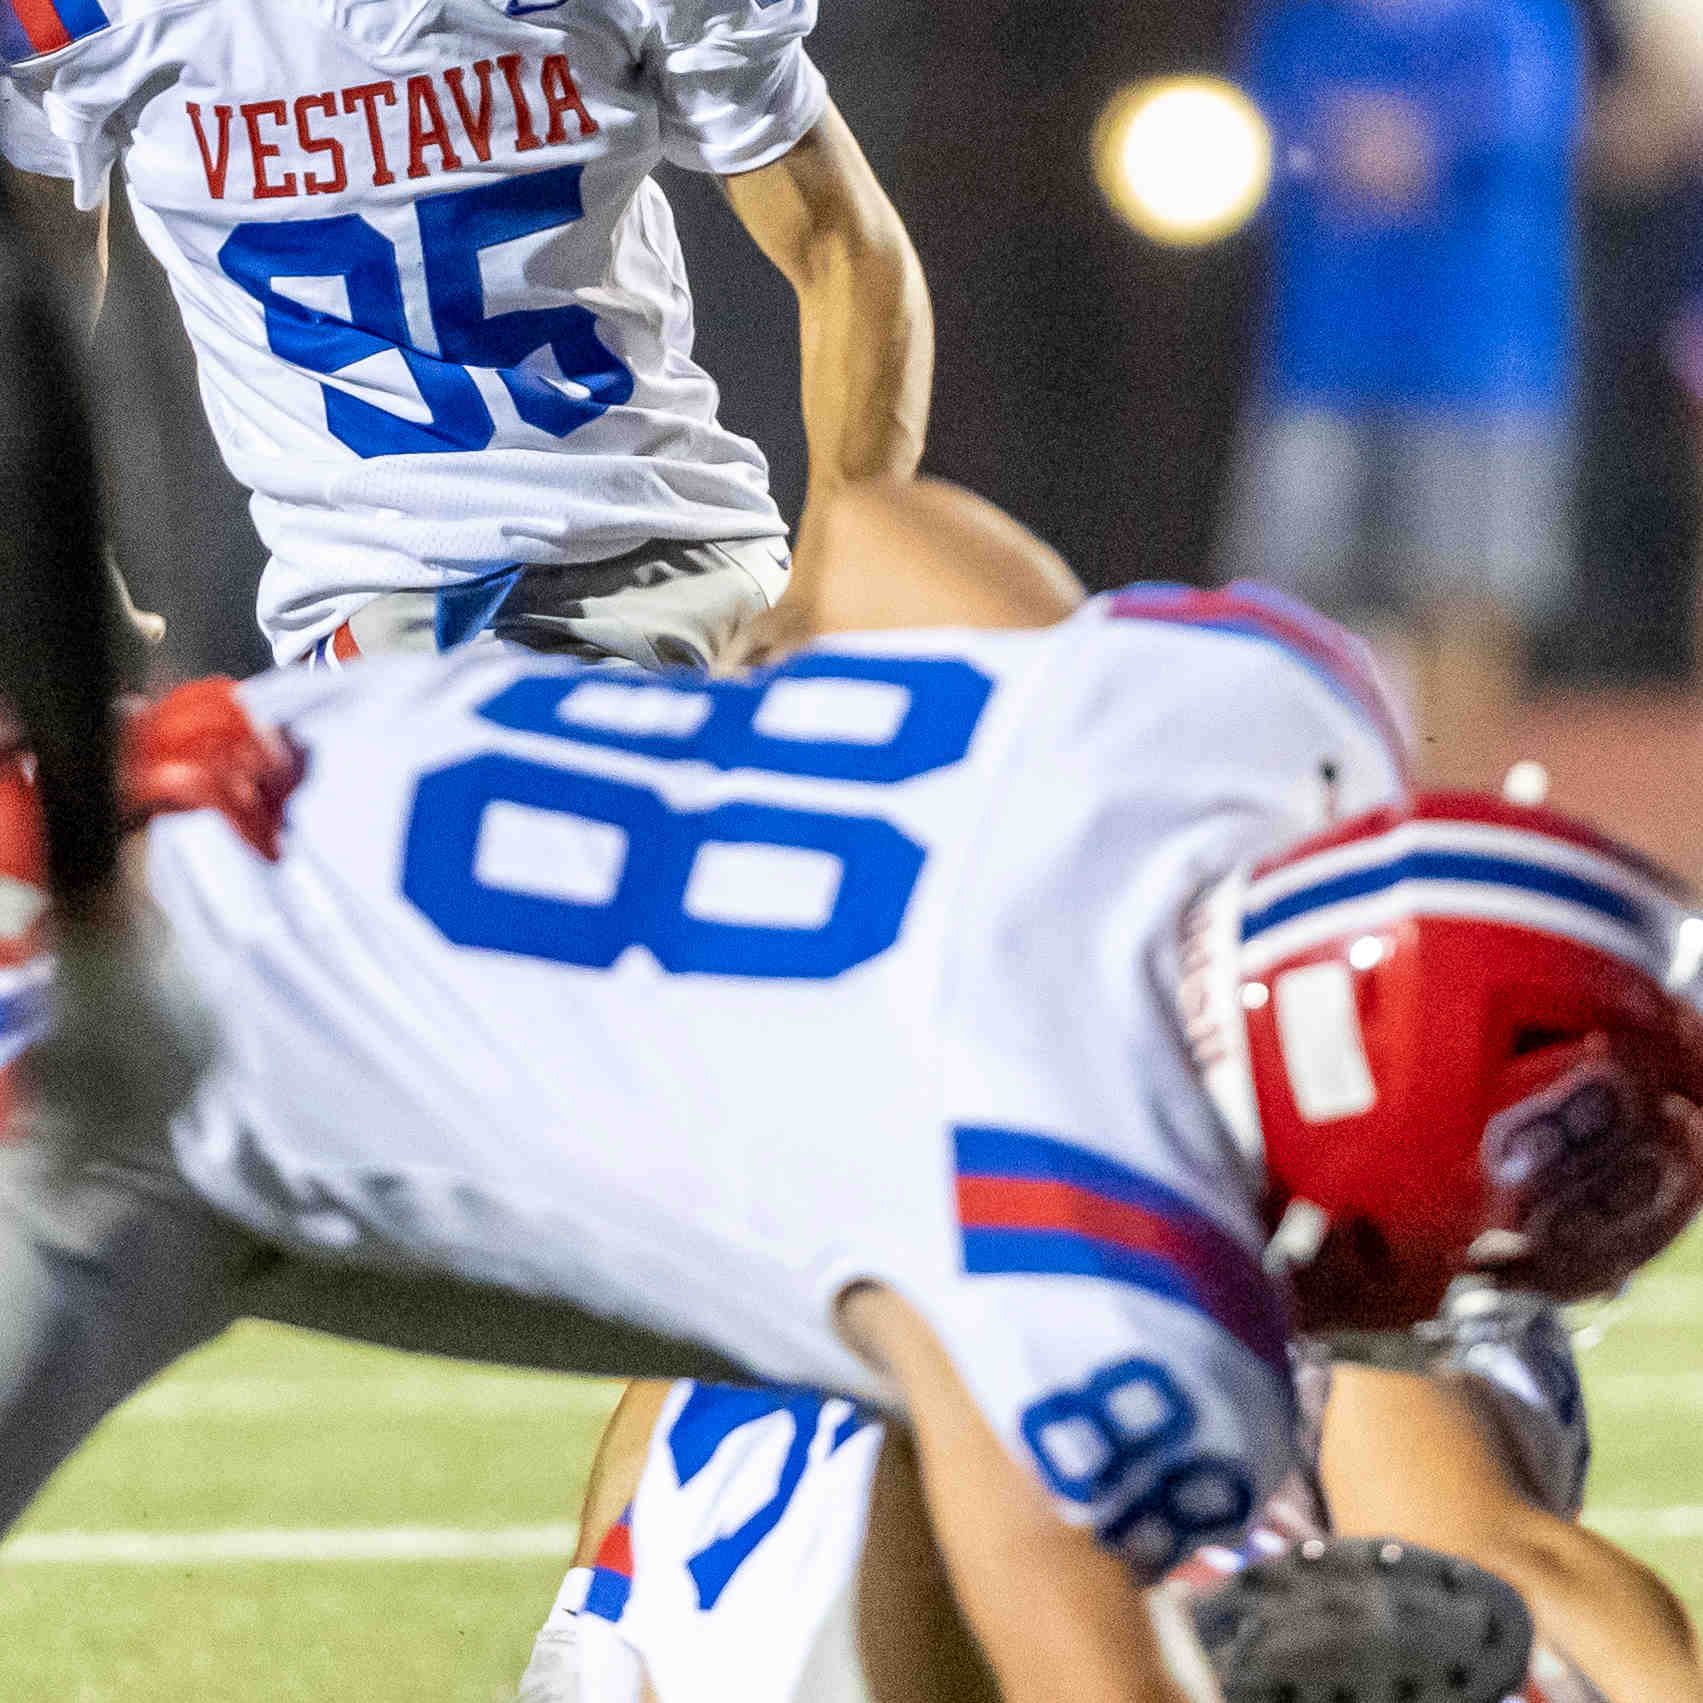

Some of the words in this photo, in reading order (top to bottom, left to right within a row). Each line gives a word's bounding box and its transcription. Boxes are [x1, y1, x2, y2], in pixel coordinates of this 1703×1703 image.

[186, 54, 598, 200] VESTAVIA
[217, 163, 635, 459] 95
[398, 651, 997, 981] 88
[1018, 1357, 1255, 1584] 88
